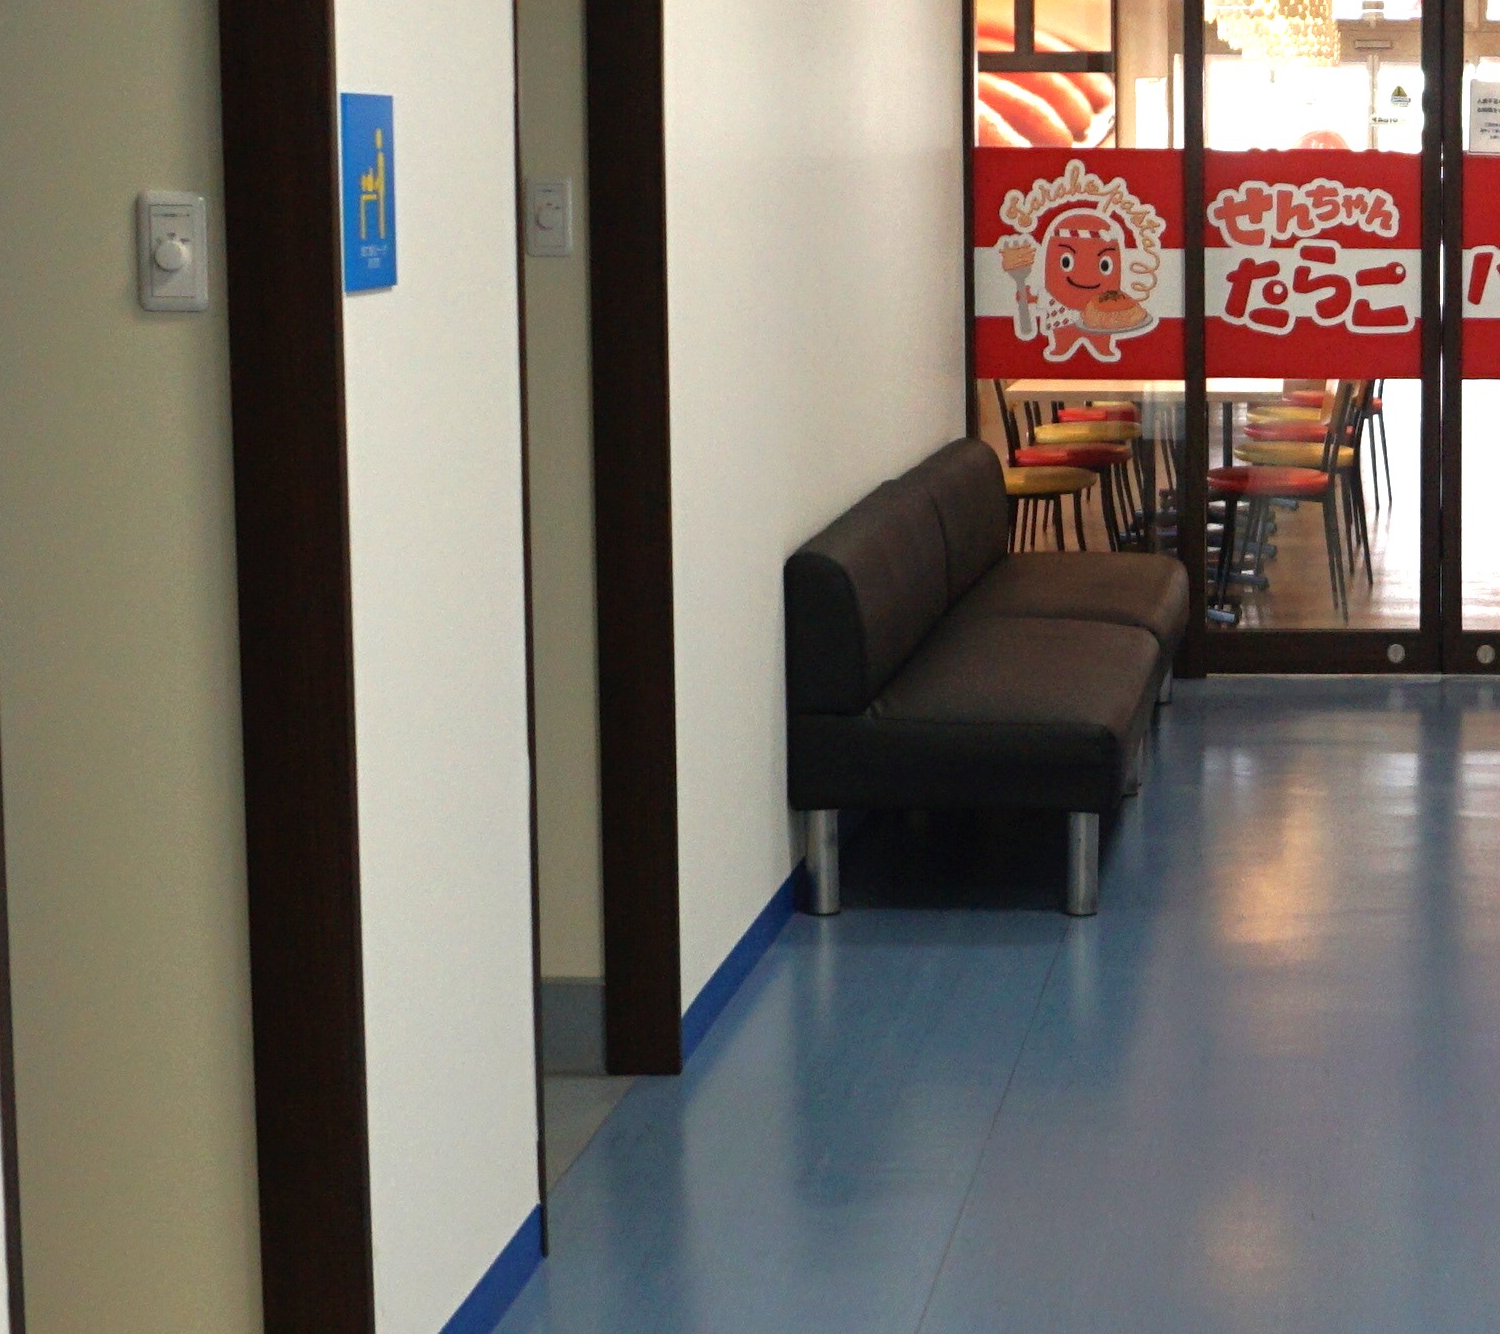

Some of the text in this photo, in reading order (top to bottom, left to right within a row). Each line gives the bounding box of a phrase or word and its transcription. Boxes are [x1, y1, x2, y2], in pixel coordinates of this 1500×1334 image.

[1211, 182, 1396, 248] せんちゃん
[1223, 244, 1411, 329] たらこ
